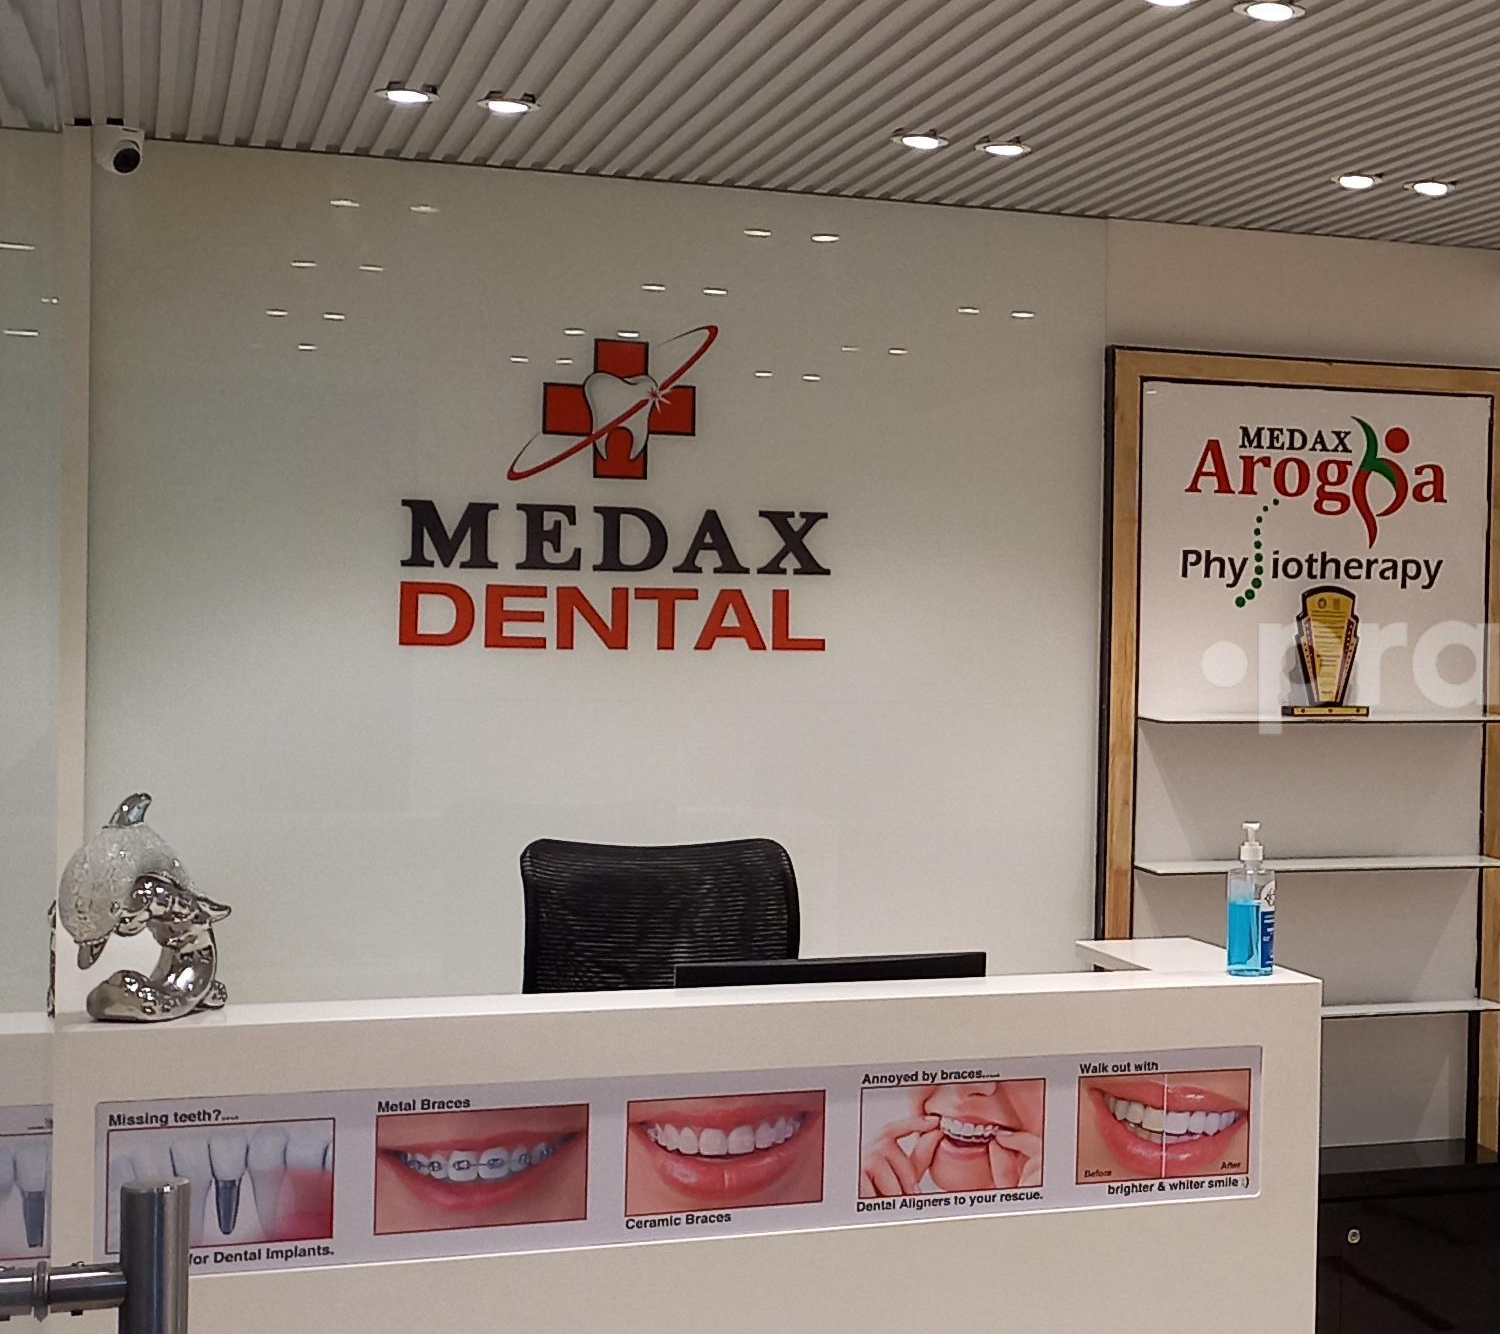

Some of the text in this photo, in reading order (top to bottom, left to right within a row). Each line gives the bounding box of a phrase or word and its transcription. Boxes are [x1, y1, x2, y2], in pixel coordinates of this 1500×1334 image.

[1239, 426, 1352, 453] MEDAX
[400, 499, 831, 575] MEDAX
[399, 581, 826, 651] DENTAL
[1079, 1061, 1159, 1074] Walk out with
[862, 1071, 919, 1085] Annoyed
[922, 1070, 938, 1083] by
[377, 1099, 471, 1113] Metal Braces
[108, 1113, 169, 1126] Missing
[1108, 1182, 1154, 1196] brighter
[1157, 1182, 1166, 1192] &
[1169, 1179, 1205, 1191] whiter
[1208, 1177, 1239, 1188] smile
[856, 1191, 1044, 1212] Dental Aligners to your rescue.
[625, 1213, 732, 1229] Ceramic Braces
[213, 1248, 262, 1264] Dental
[266, 1245, 335, 1261] Implants.
